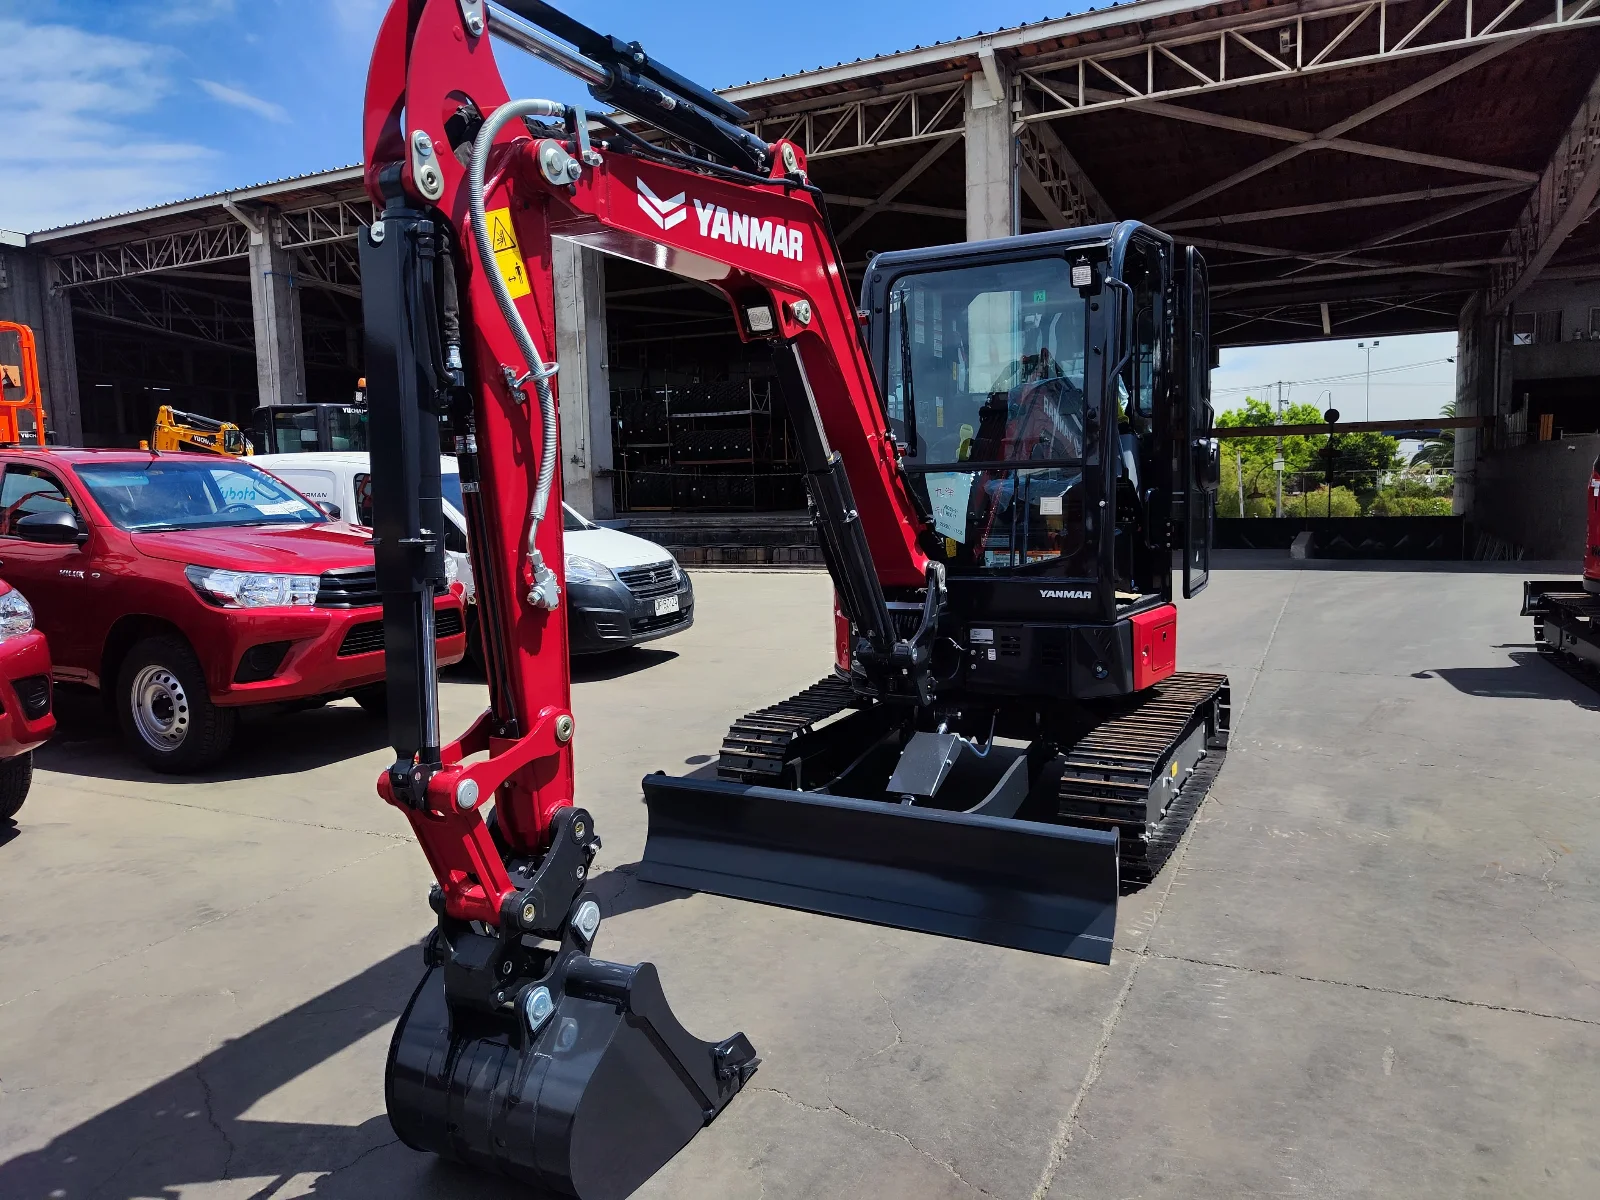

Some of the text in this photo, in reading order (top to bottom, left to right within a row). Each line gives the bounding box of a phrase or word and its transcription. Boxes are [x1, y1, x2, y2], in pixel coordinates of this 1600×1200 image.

[693, 199, 803, 262] YANMAR
[193, 434, 211, 446] YUCHA
[220, 486, 256, 501] ubota
[1039, 590, 1092, 599] YANMAR
